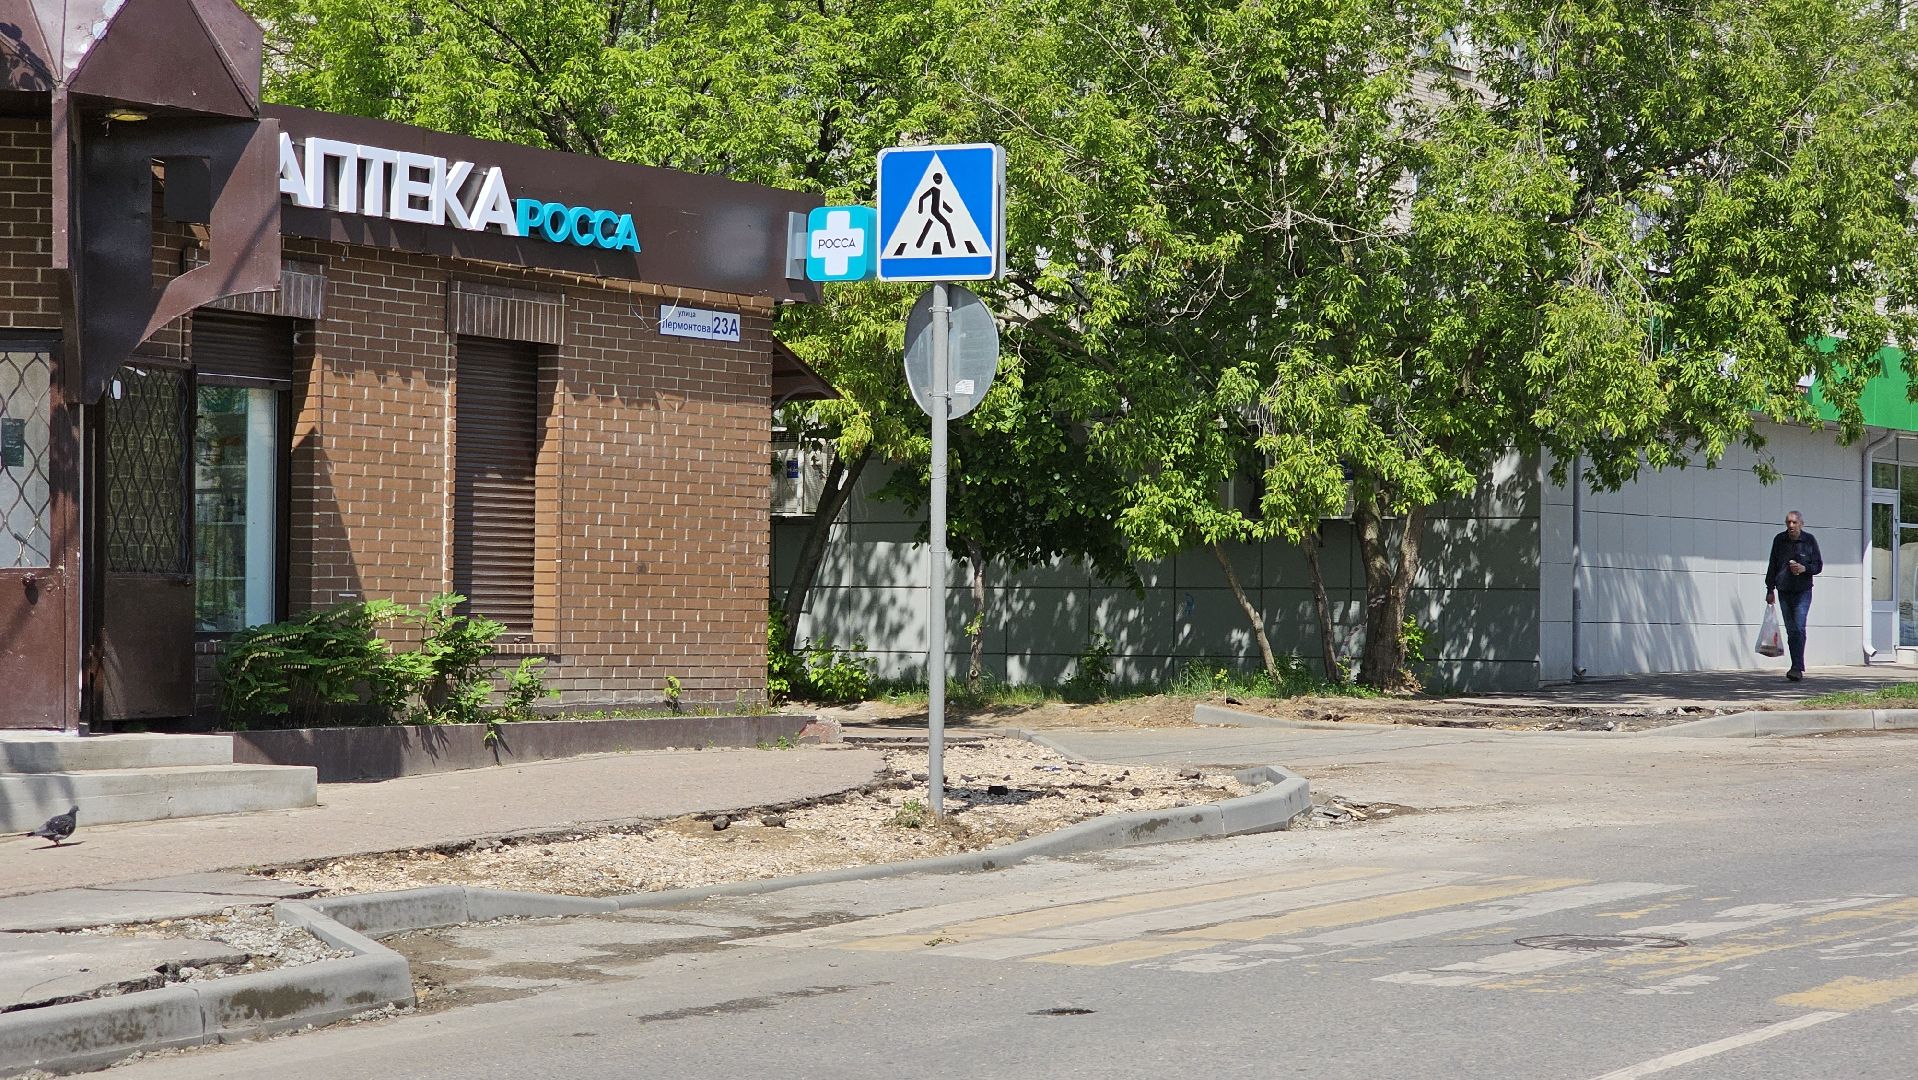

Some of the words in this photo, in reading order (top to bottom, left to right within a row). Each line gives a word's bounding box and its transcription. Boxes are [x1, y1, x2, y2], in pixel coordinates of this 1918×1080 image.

[516, 198, 642, 253] РОССА
[818, 237, 856, 249] РОССА
[677, 310, 697, 318] улица
[661, 318, 711, 333] Лермонтова
[713, 316, 739, 336] 23А
